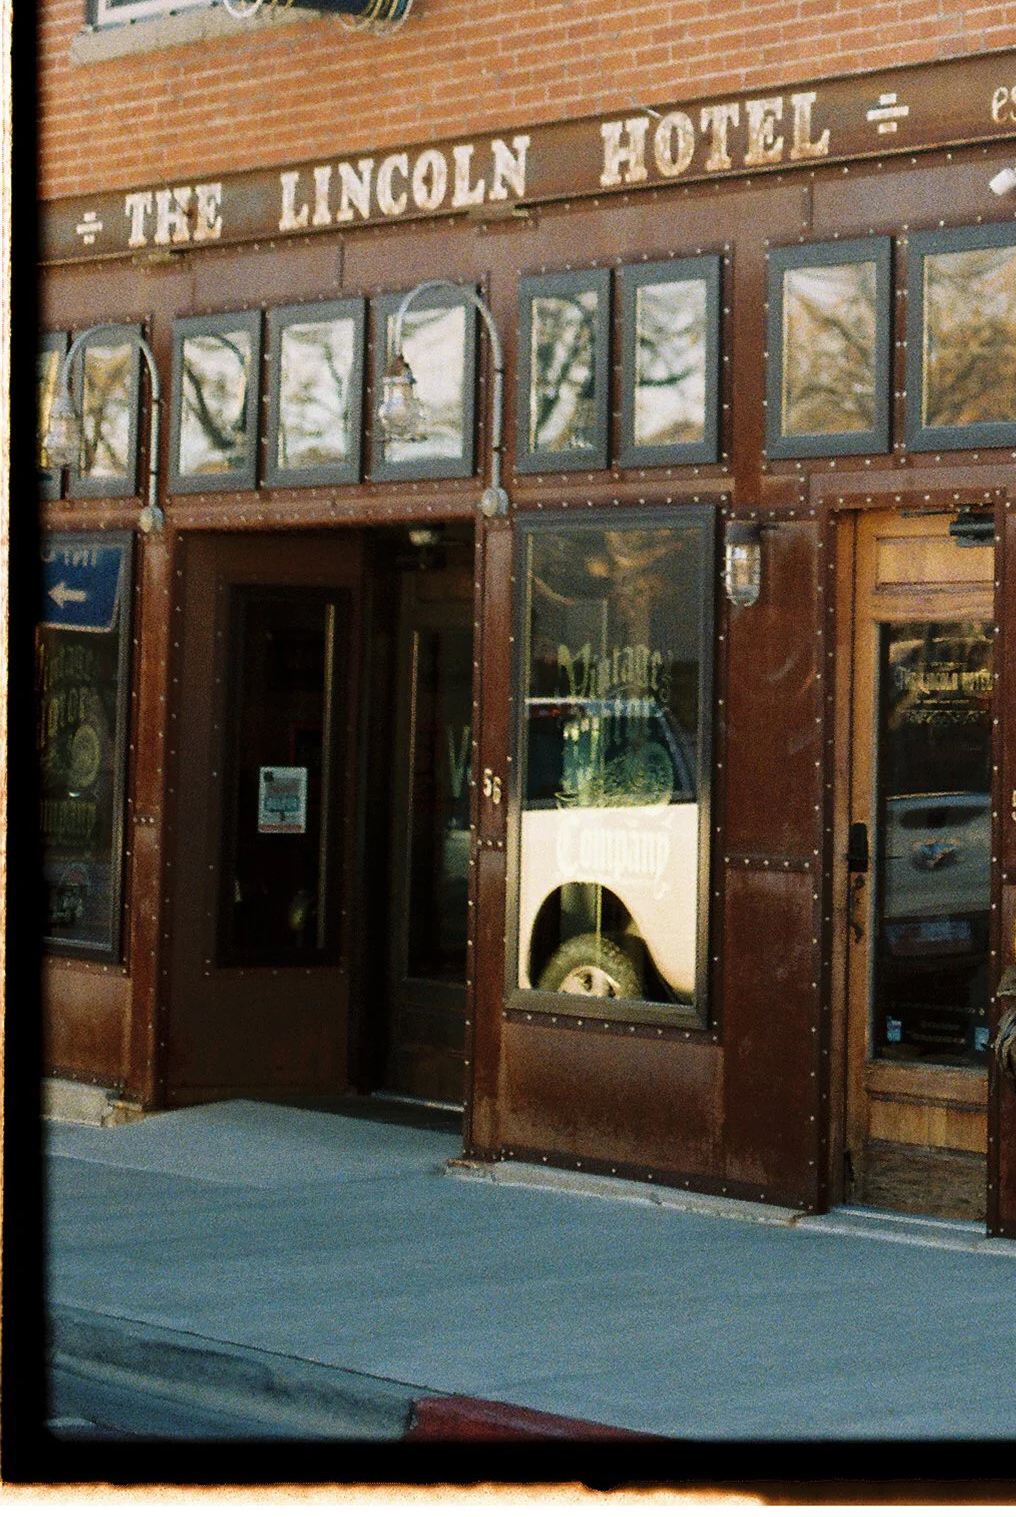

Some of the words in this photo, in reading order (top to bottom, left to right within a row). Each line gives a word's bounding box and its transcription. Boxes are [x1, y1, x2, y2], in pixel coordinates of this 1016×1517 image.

[124, 183, 223, 249] THE
[278, 135, 532, 232] LINCOLN
[599, 91, 829, 186] HOTEL
